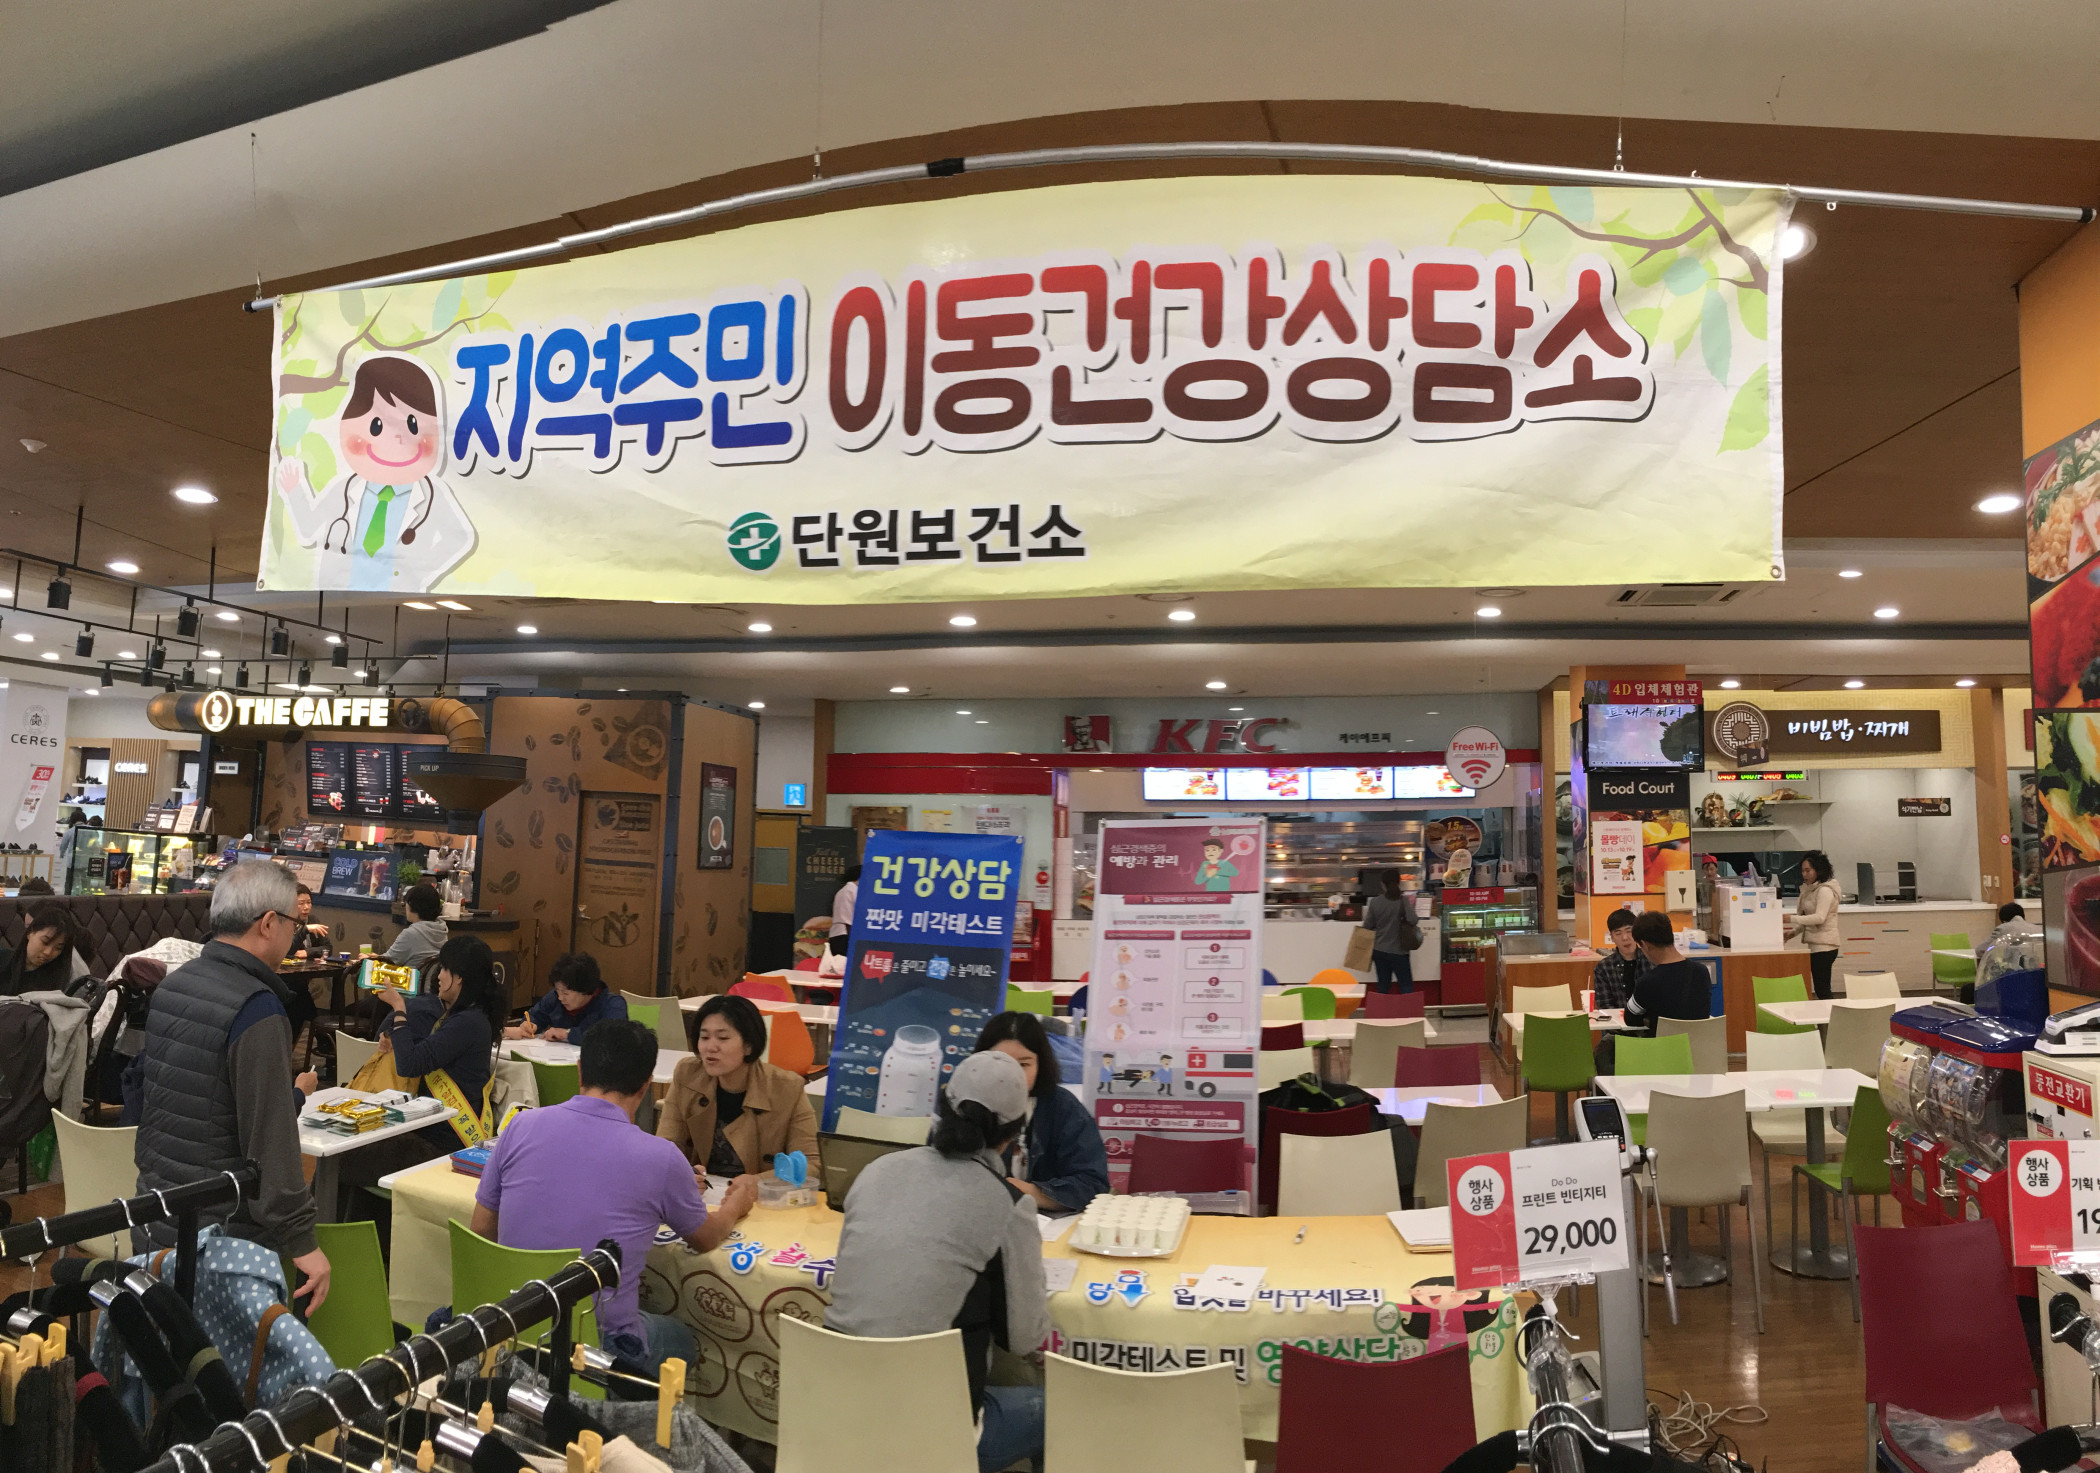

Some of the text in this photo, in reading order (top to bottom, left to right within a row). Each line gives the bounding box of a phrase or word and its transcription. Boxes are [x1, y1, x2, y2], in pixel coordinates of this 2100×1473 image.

[453, 256, 1643, 463] 지역주민 이동건강상담소
[792, 504, 1086, 567] 단원보건소
[1613, 683, 1699, 696] 4D 입체체험관
[236, 696, 389, 727] THE CAFFE
[11, 733, 58, 748] CERES
[1152, 718, 1280, 753] KFC
[1452, 742, 1499, 751] Free Wi-Fi
[1602, 782, 1675, 794] Food Court
[806, 856, 846, 866] CHEESE
[1109, 855, 1179, 868] 예방과 관리
[332, 866, 353, 876] BREW
[872, 856, 1012, 900] 건강상담
[865, 908, 1003, 935] 짠맛 미각테스트
[901, 960, 926, 974] 줄이고
[2035, 1071, 2085, 1109] 동전교환기
[2026, 1157, 2049, 1172] 행사
[1469, 1179, 1494, 1194] 행사
[1552, 1177, 1577, 1187] Do Do
[2026, 1173, 2050, 1187] 상품
[2072, 1177, 2094, 1190] 기획
[1470, 1195, 1495, 1211] 상품
[1522, 1185, 1607, 1208] 프린트 빈티지티
[1524, 1217, 1617, 1255] 29,000
[1259, 1289, 1380, 1310] 바꾸세요!
